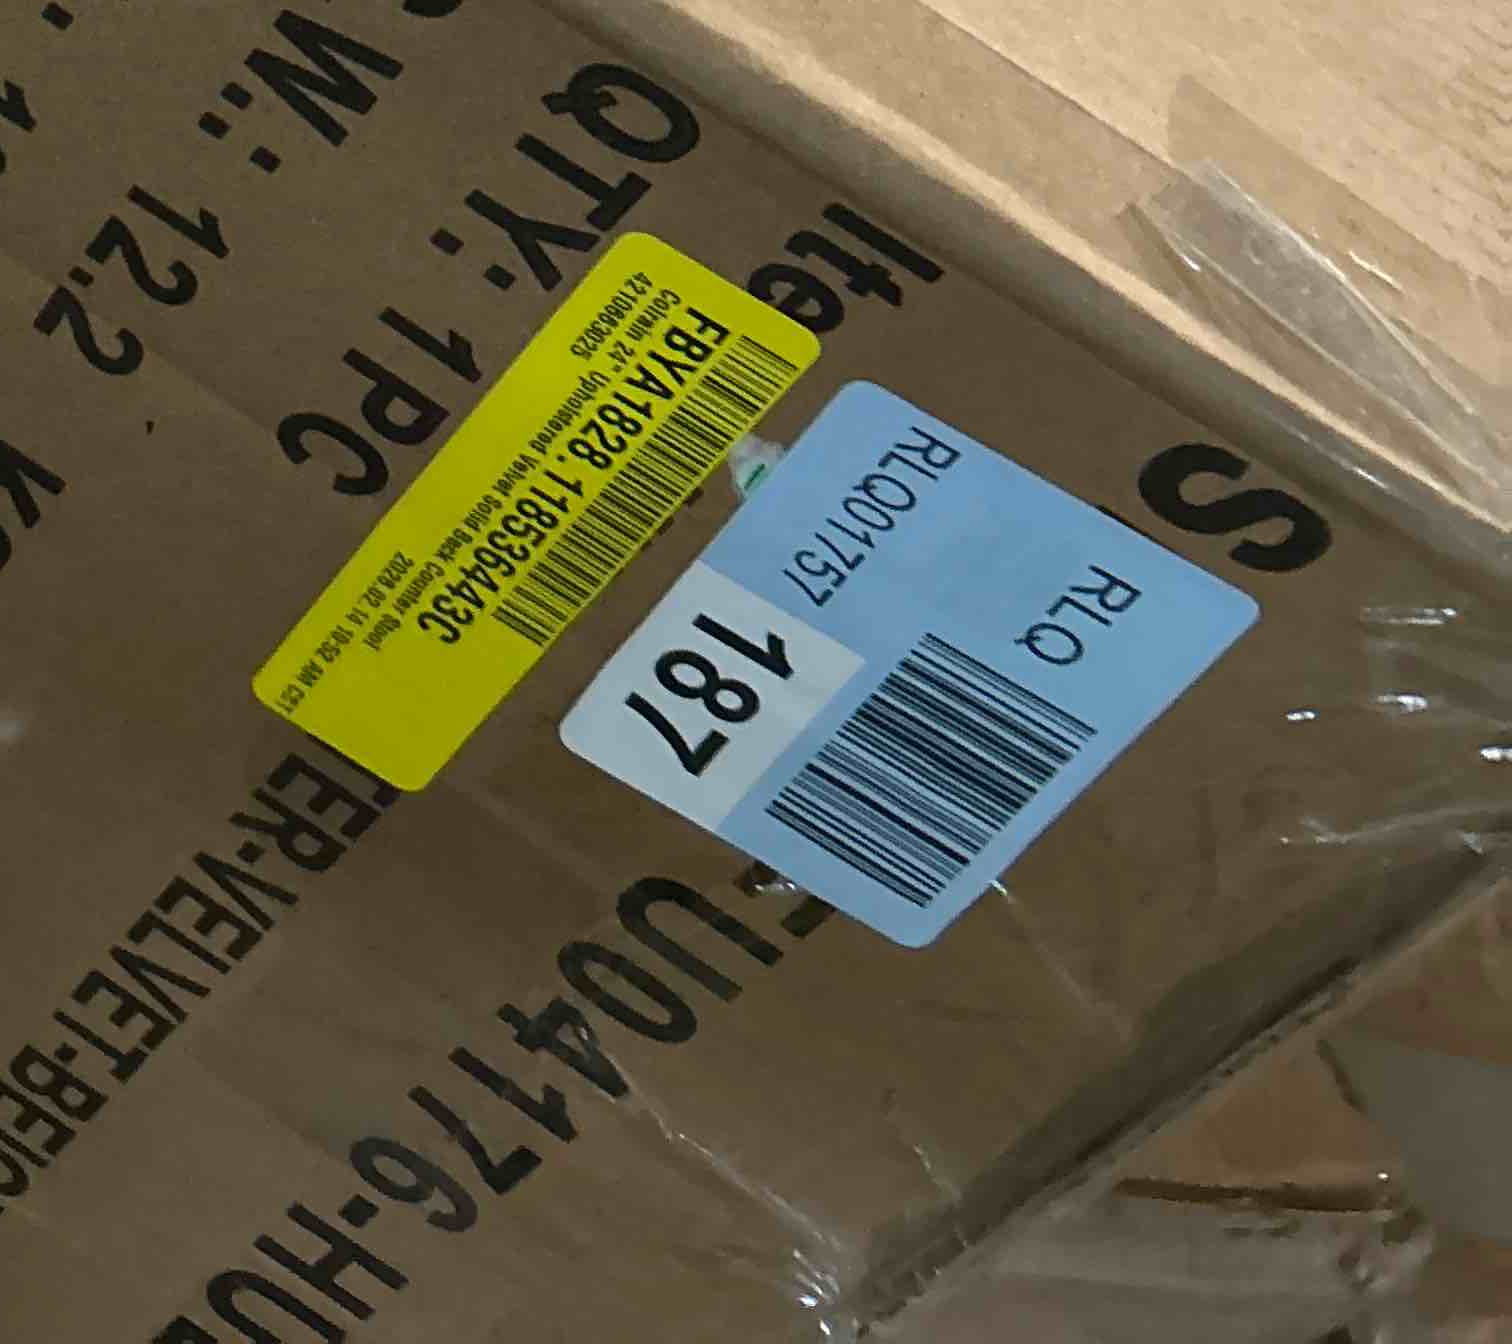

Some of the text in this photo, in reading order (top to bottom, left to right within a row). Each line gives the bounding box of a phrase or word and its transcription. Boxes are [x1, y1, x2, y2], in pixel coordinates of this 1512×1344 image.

[34, 185, 229, 376] 12.2
[277, 63, 700, 496] QTY: 1PC
[747, 202, 944, 334] Ite
[625, 289, 681, 341] Colrain
[528, 371, 611, 456] Upholstered
[418, 307, 730, 644] FBYA1828.118536443C
[462, 495, 502, 533] Solid
[492, 454, 539, 497] Velvet
[783, 426, 960, 607] RLQ01757
[434, 528, 473, 562] Back
[392, 562, 444, 616] Counter
[1014, 566, 1141, 665] RLQ
[297, 659, 323, 688] AM
[363, 614, 401, 651] Stool
[625, 614, 793, 777] 187
